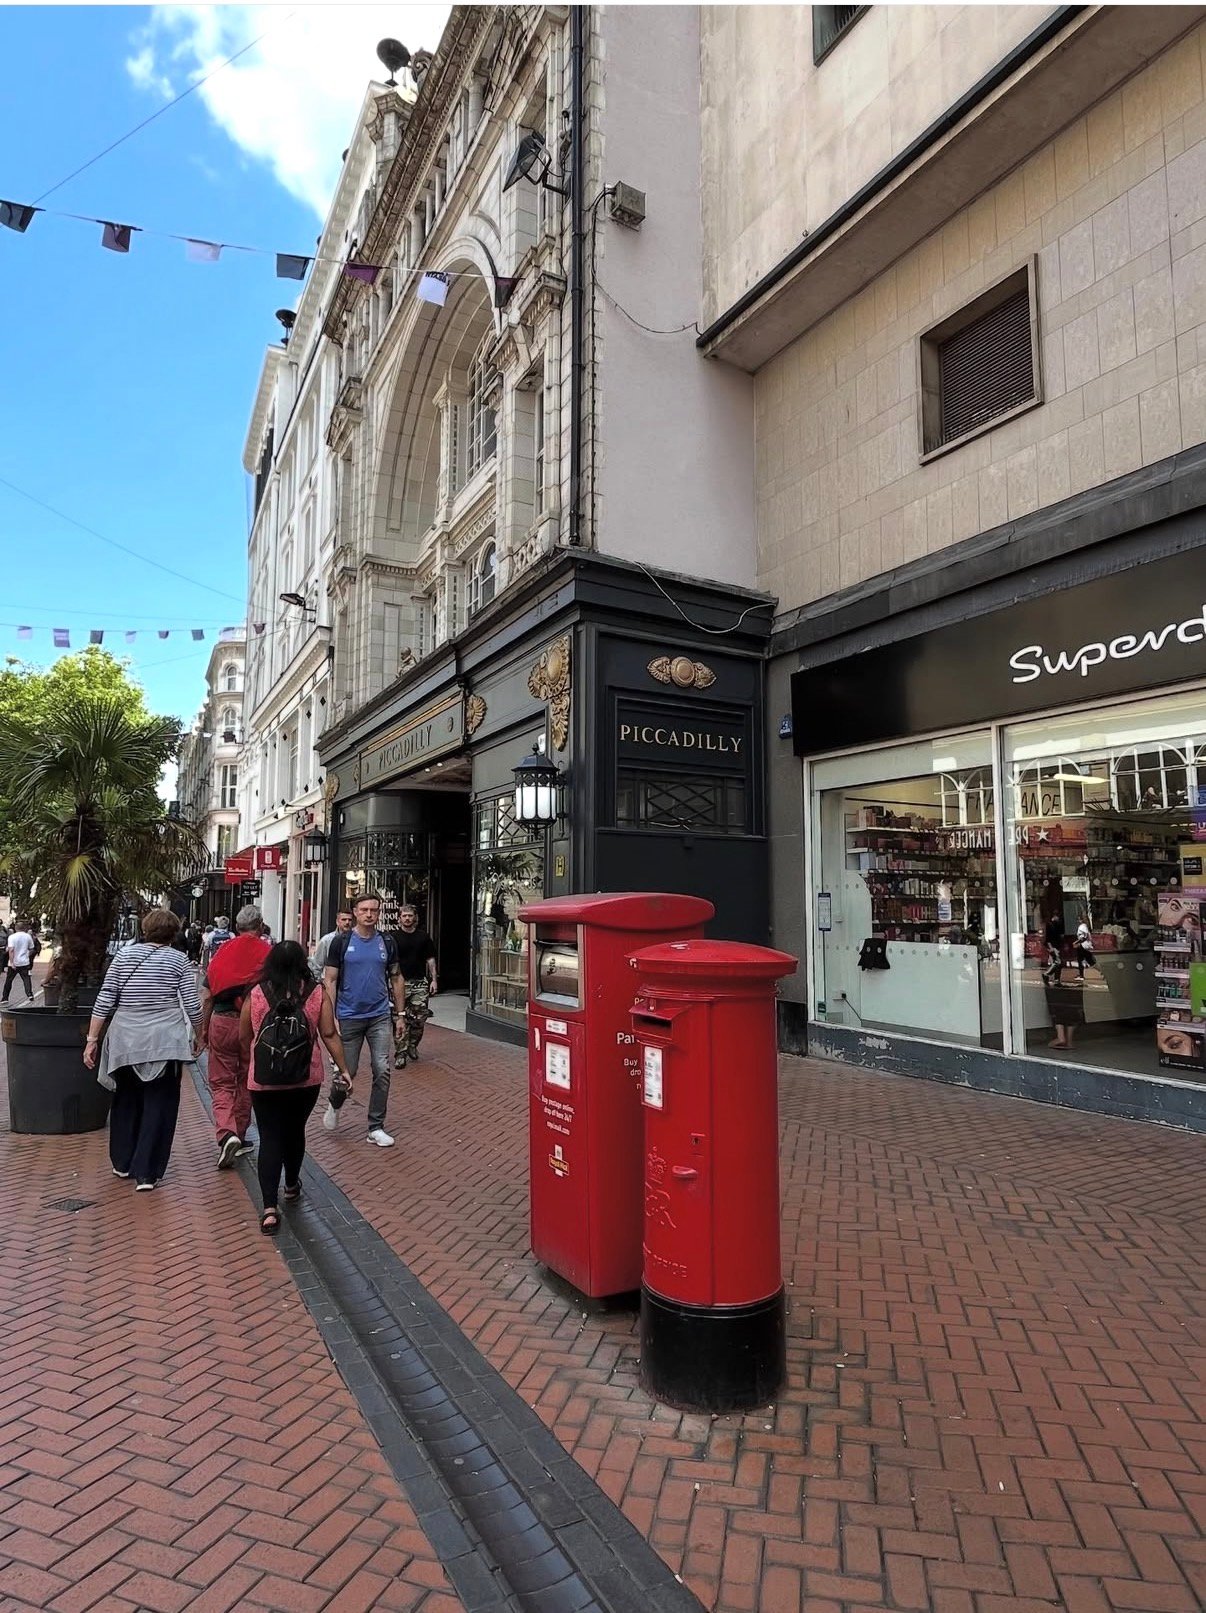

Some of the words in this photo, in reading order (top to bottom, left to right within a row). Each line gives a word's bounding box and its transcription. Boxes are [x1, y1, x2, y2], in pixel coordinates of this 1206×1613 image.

[1009, 604, 1206, 683] Superd
[379, 724, 432, 771] PICCADILLY
[619, 724, 741, 753] PICCADILLY
[623, 1058, 638, 1067] Buy
[630, 1068, 642, 1076] dro
